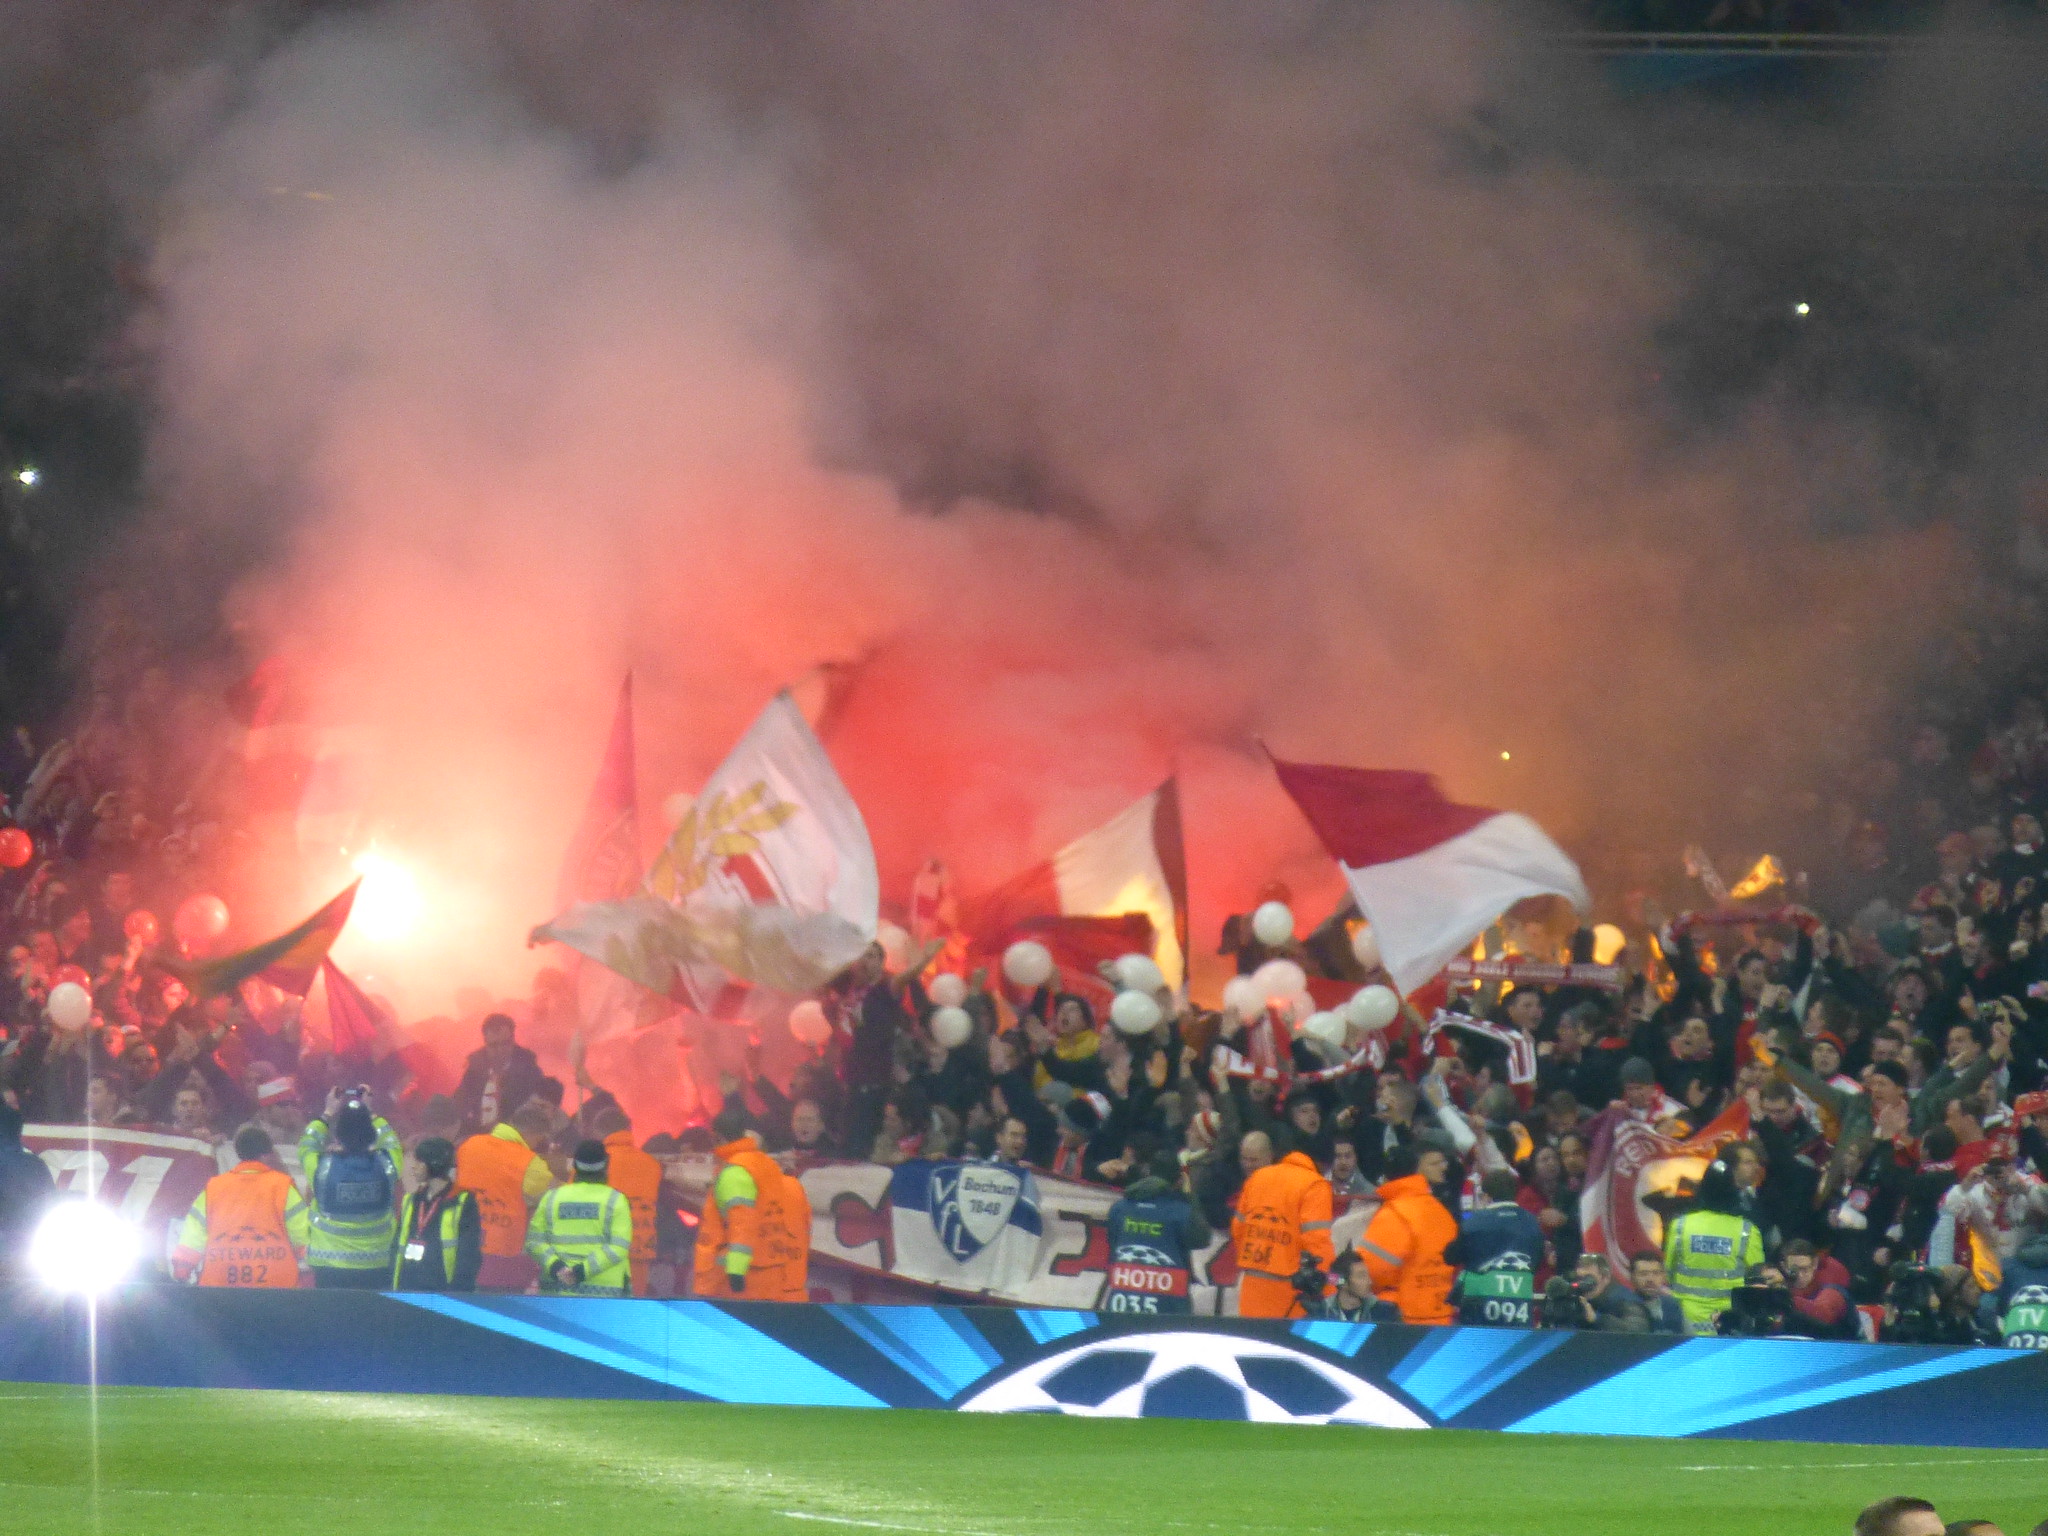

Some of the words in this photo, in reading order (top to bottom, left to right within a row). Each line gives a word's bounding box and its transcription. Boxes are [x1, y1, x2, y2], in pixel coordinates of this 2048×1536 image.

[964, 1177, 1017, 1195] Bochum
[970, 1199, 1001, 1215] 1848
[1124, 1217, 1164, 1236] htc
[209, 1247, 287, 1262] STEWARD
[227, 1266, 268, 1283] 882
[1113, 1267, 1174, 1291] HOTO
[1495, 1274, 1524, 1293] TV
[1111, 1293, 1158, 1314] 035
[1484, 1301, 1530, 1323] 094
[2018, 1308, 2046, 1326] TV
